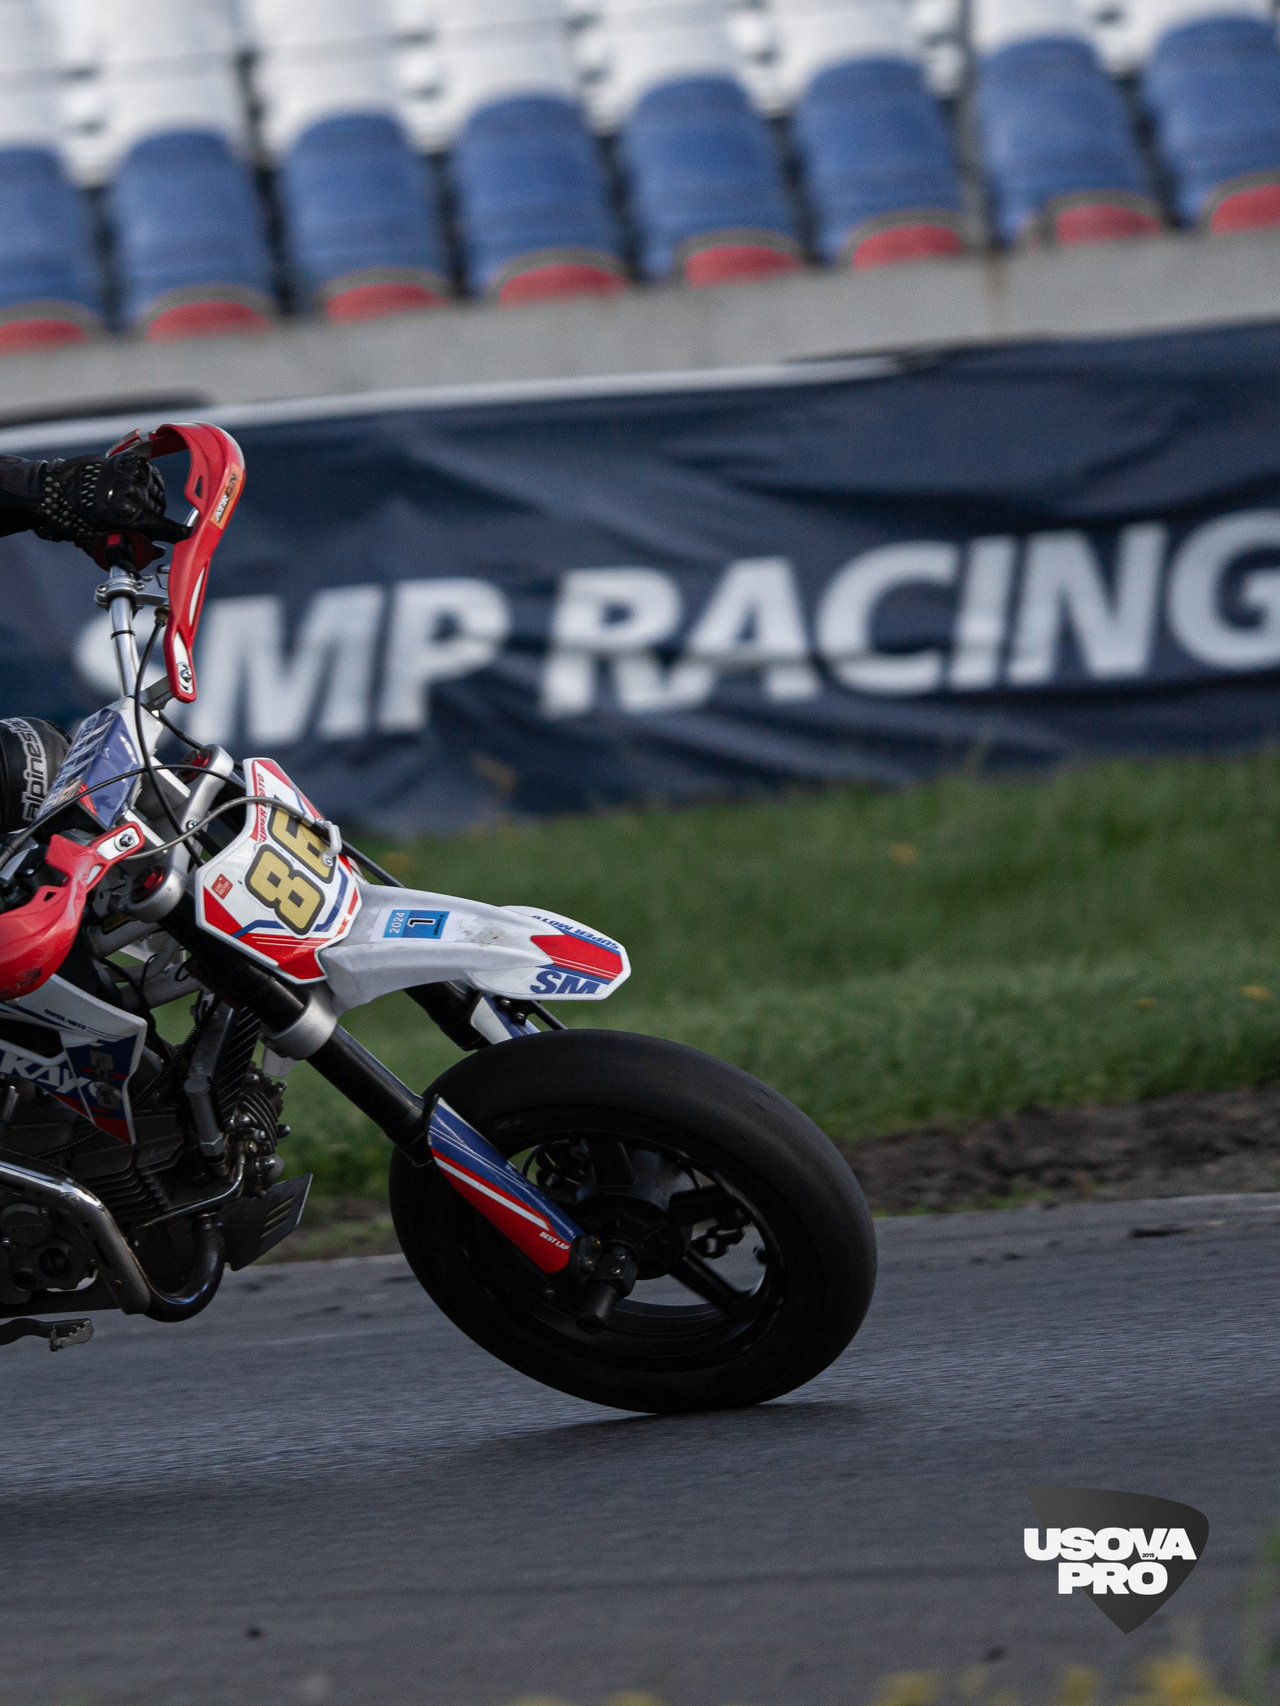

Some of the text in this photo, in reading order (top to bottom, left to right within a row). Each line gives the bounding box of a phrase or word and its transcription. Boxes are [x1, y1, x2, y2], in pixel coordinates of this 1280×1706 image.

[541, 509, 1280, 720] RACING
[245, 797, 337, 936] 86
[388, 911, 406, 934] 2024
[407, 916, 436, 928] 1
[575, 928, 620, 950] SUPER
[530, 970, 601, 994] SM
[539, 1232, 570, 1250] BEST LAP
